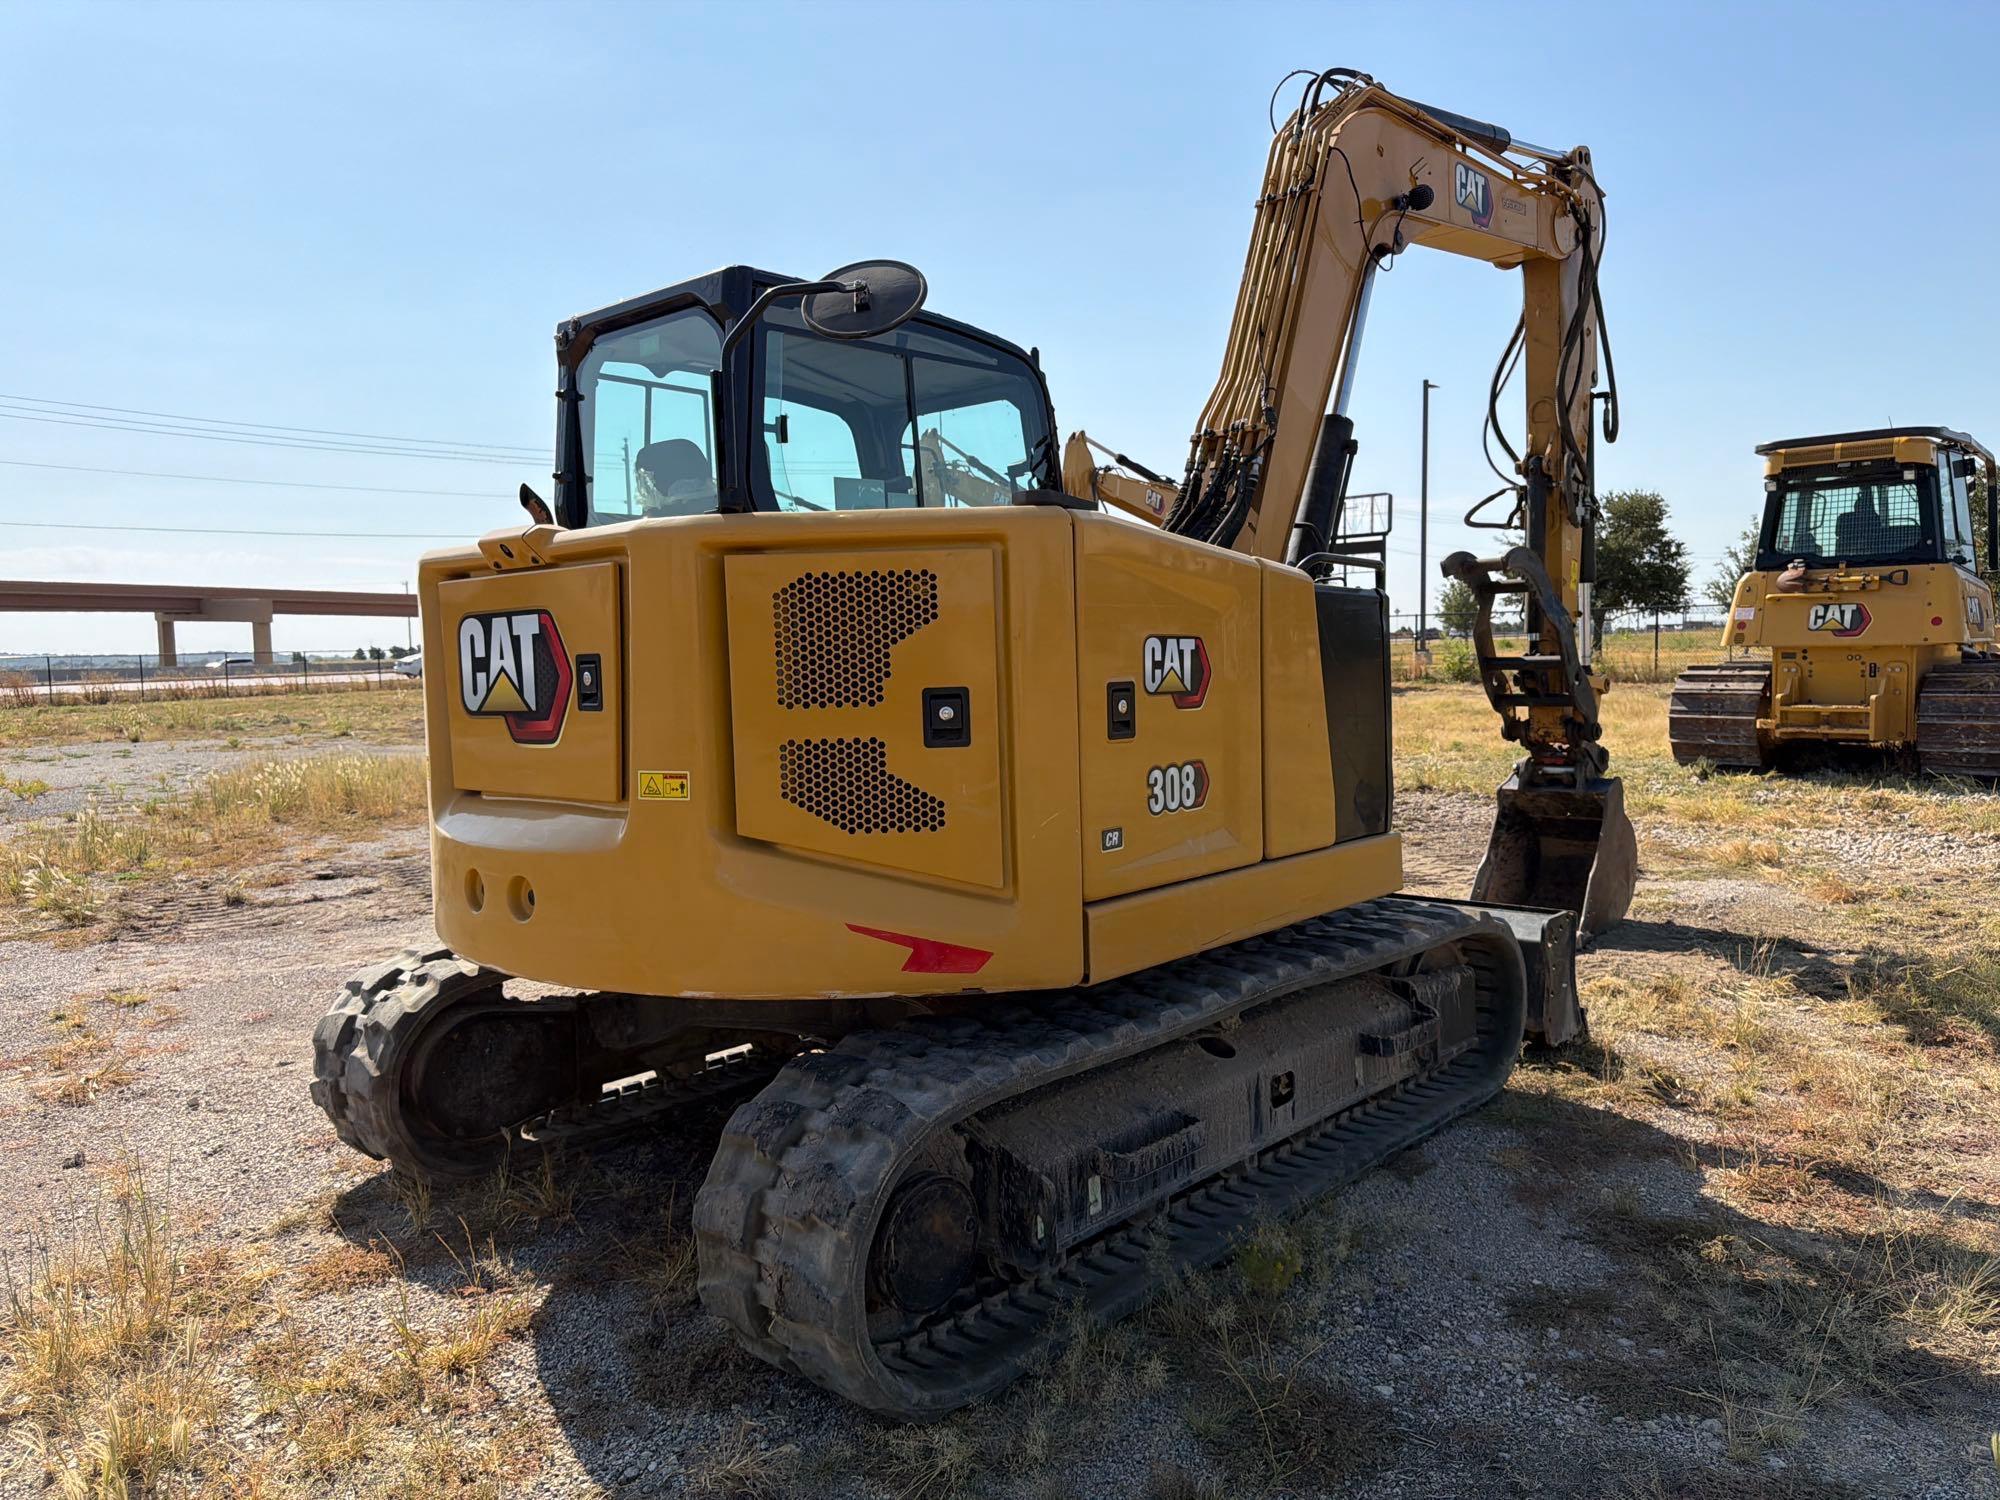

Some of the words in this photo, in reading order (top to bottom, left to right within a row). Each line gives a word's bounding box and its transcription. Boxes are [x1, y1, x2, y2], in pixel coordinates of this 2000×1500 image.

[1456, 163, 1485, 214] CAT
[1146, 489, 1161, 509] CAT
[1808, 604, 1857, 630] CAT
[459, 613, 540, 712] CAT
[1144, 636, 1196, 693] CAT
[1148, 763, 1196, 813] 308
[1105, 831, 1119, 847] CR
